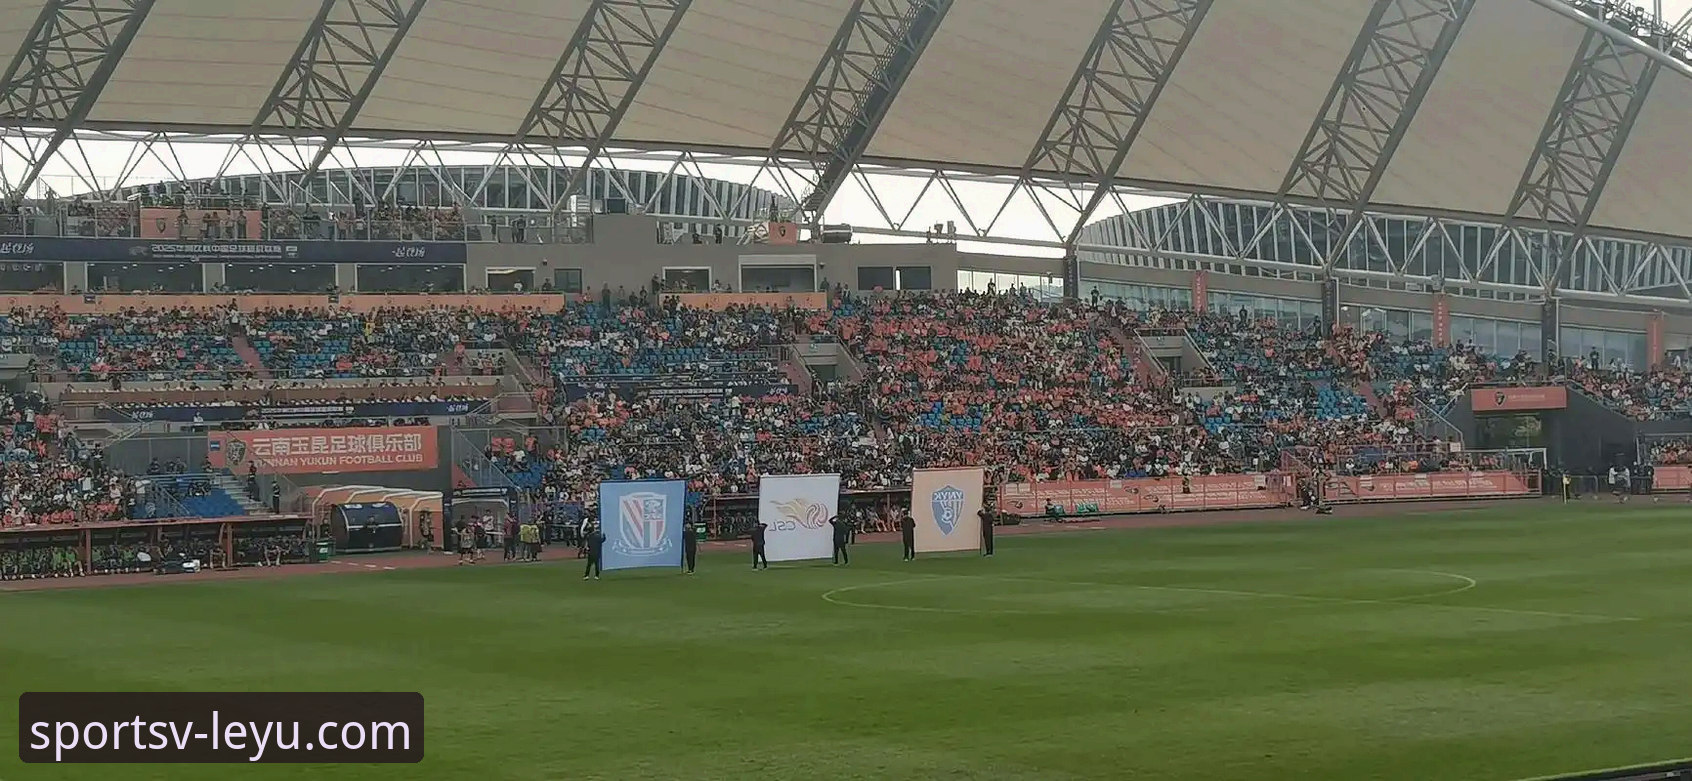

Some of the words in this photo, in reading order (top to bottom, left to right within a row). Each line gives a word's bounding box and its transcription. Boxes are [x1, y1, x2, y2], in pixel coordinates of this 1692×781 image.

[252, 433, 421, 456] 云南玉昆足球俱乐部
[299, 456, 337, 466] YUKUN
[339, 455, 394, 465] FOOTBALL
[395, 453, 423, 463] CLUB
